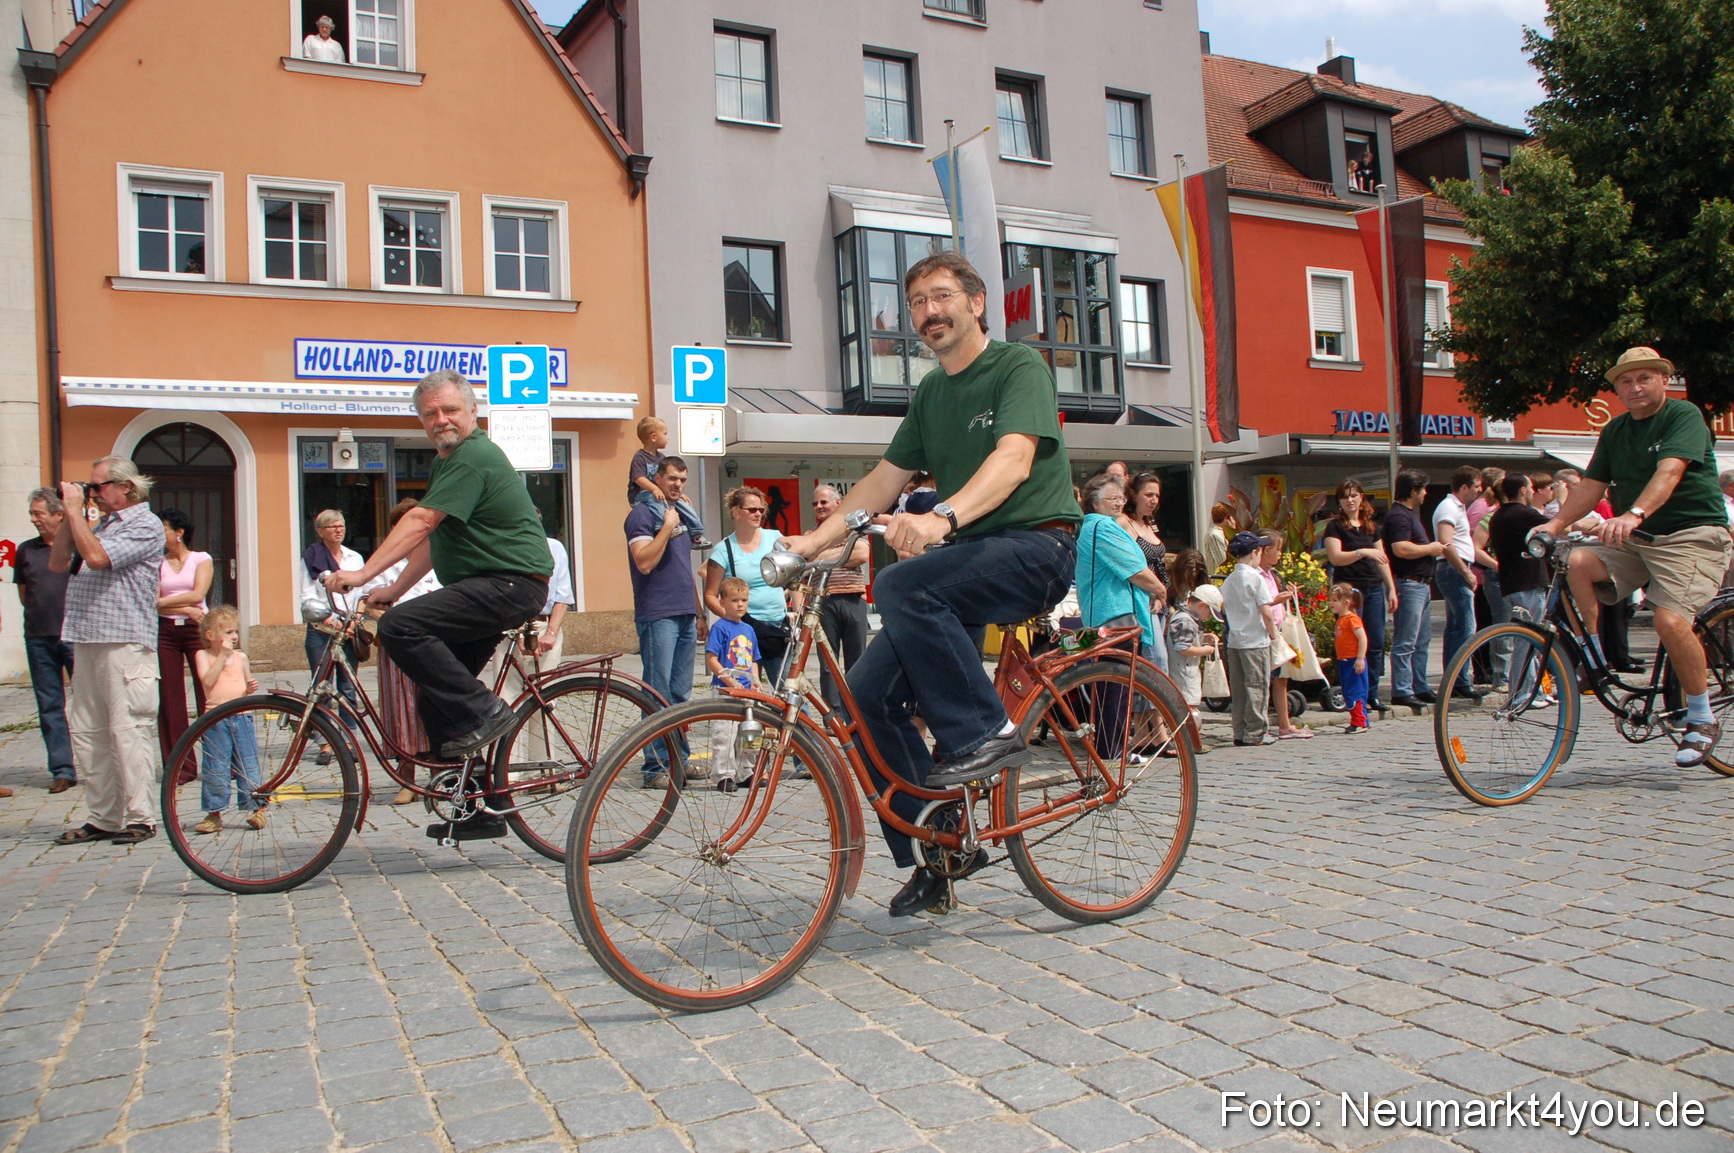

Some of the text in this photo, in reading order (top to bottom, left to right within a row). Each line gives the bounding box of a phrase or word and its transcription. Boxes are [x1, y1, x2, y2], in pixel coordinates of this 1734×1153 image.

[501, 353, 535, 398] P
[685, 354, 714, 397] P
[1332, 409, 1475, 436] TABAAREN
